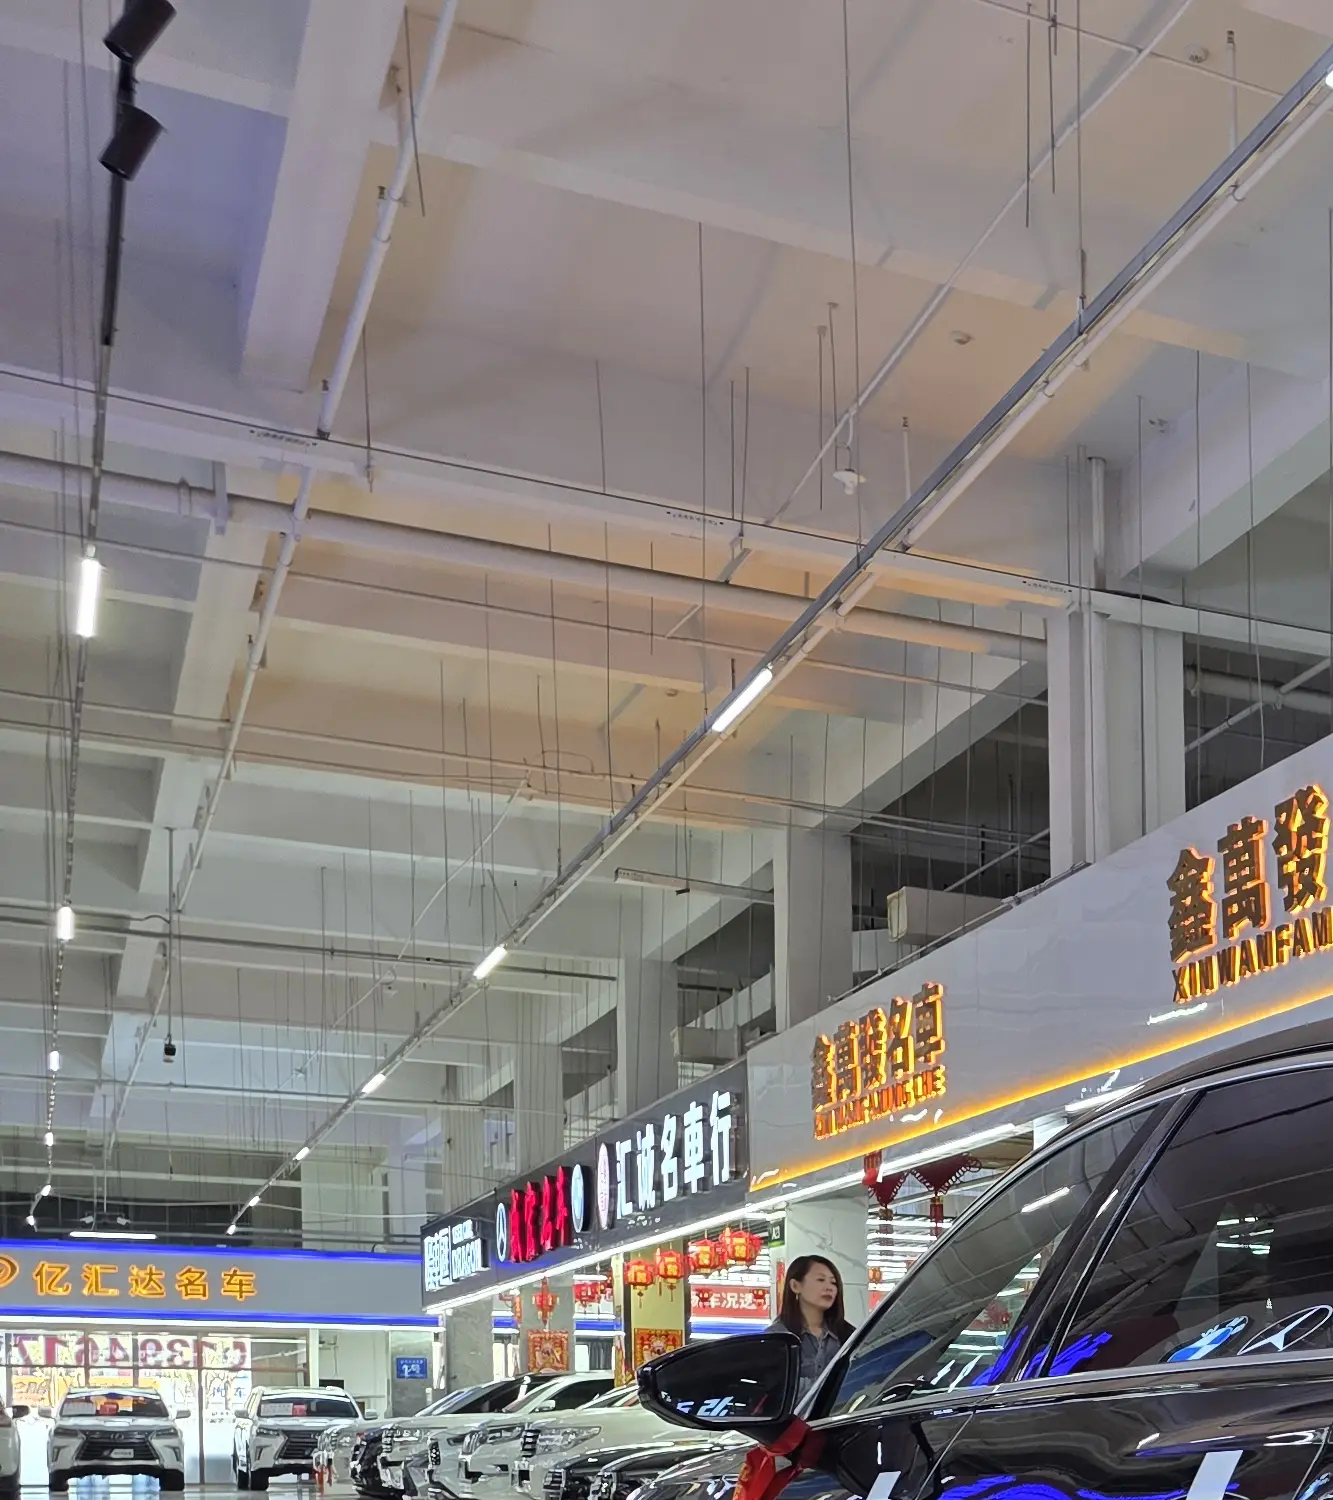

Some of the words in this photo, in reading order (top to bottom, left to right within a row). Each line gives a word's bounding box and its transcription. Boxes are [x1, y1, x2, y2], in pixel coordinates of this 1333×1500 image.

[33, 1260, 258, 1301] 亿汇达名车
